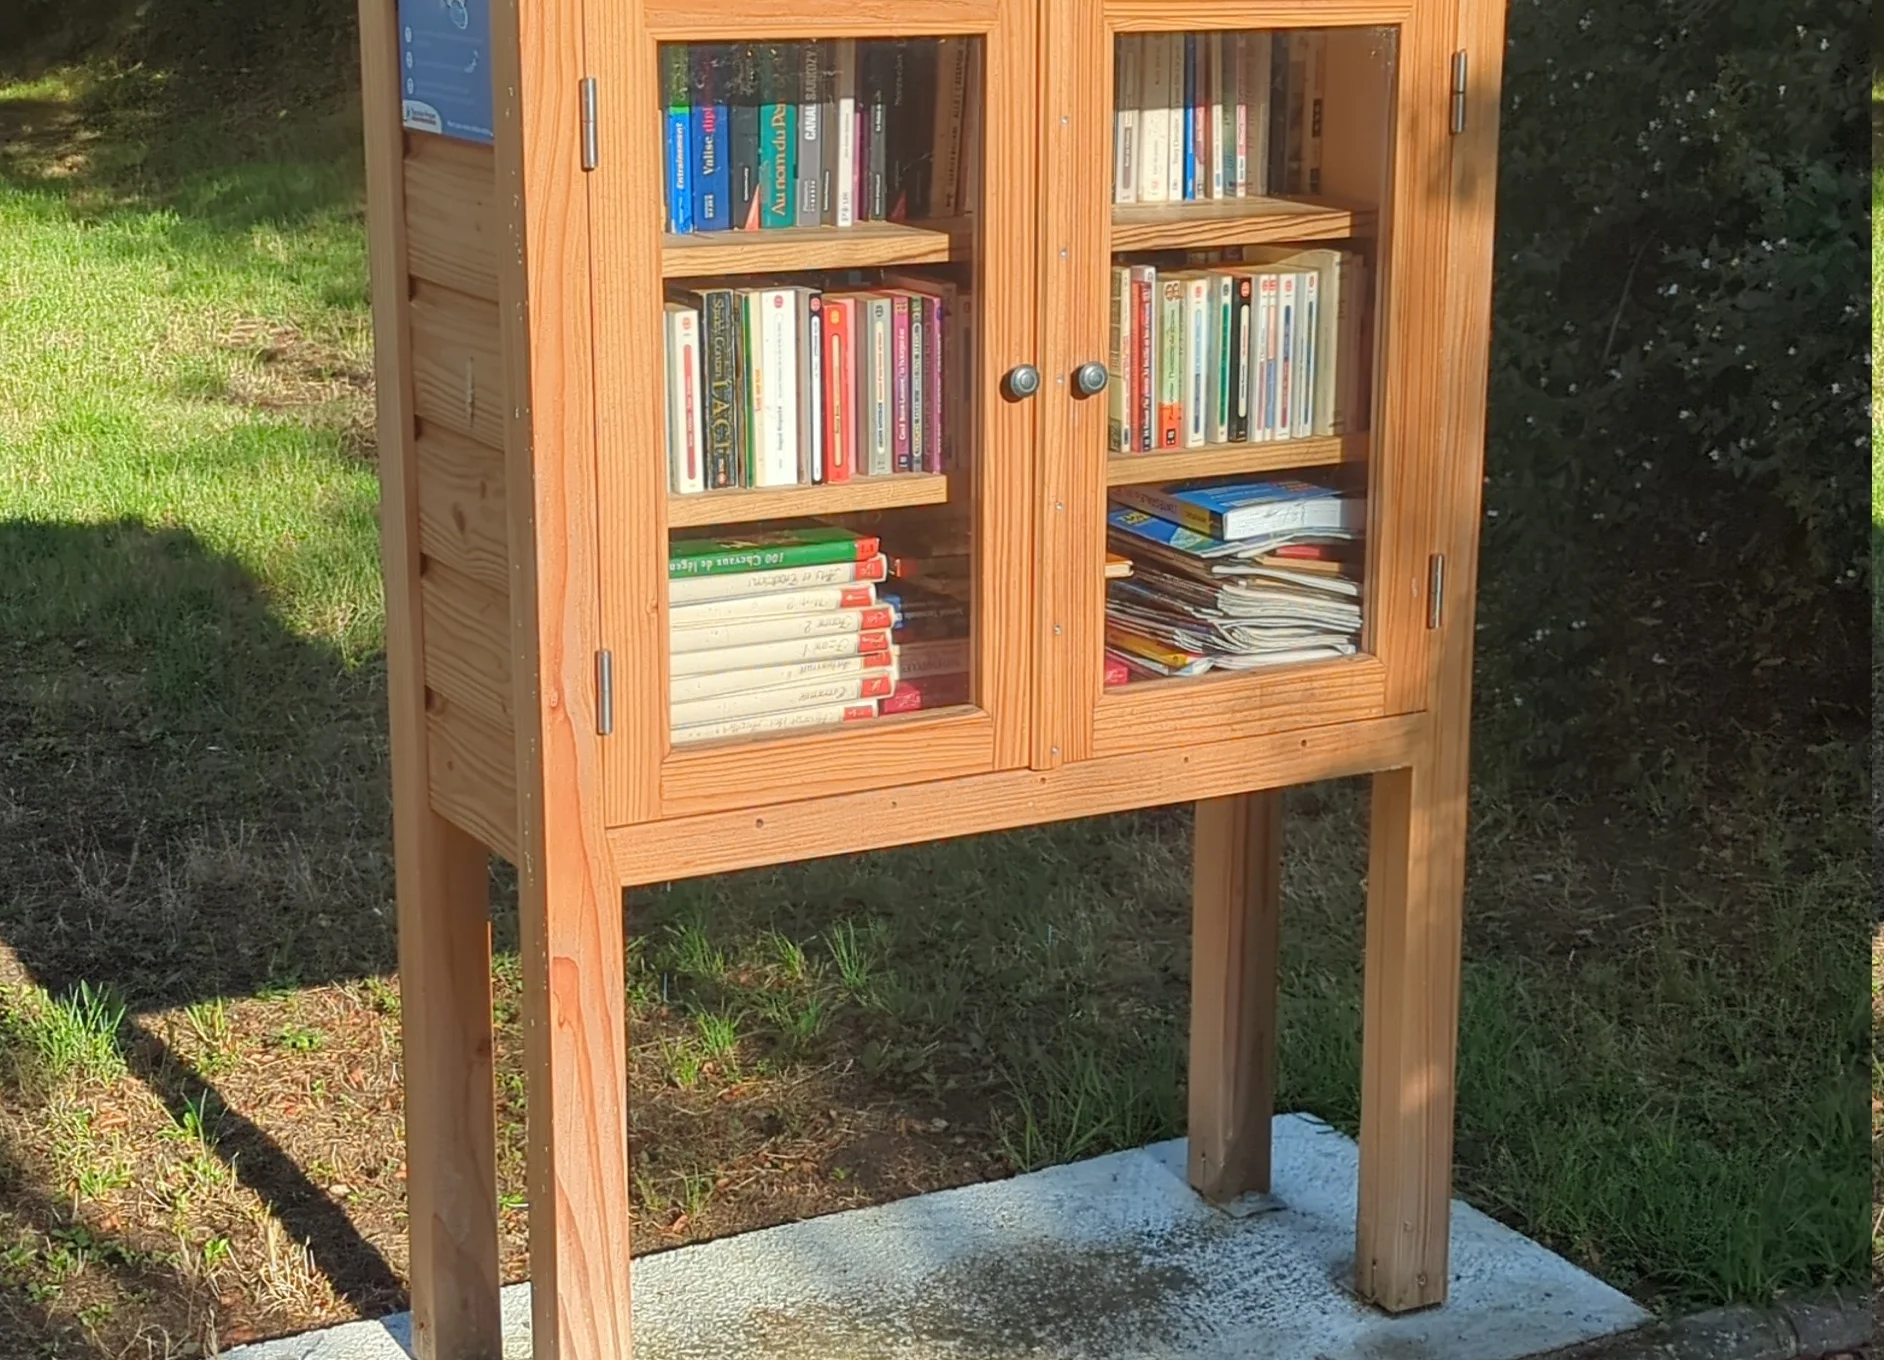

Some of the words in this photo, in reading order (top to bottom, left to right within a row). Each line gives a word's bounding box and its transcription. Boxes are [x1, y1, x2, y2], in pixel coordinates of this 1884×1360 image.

[804, 51, 818, 102] SARKOZY
[804, 104, 817, 141] CANAL
[771, 129, 786, 151] du
[703, 136, 715, 176] Valise
[772, 154, 787, 189] nom
[772, 191, 787, 216] Au
[669, 559, 698, 574] légen
[701, 558, 714, 571] de
[718, 554, 762, 569] Chevaux
[763, 552, 785, 565] 100
